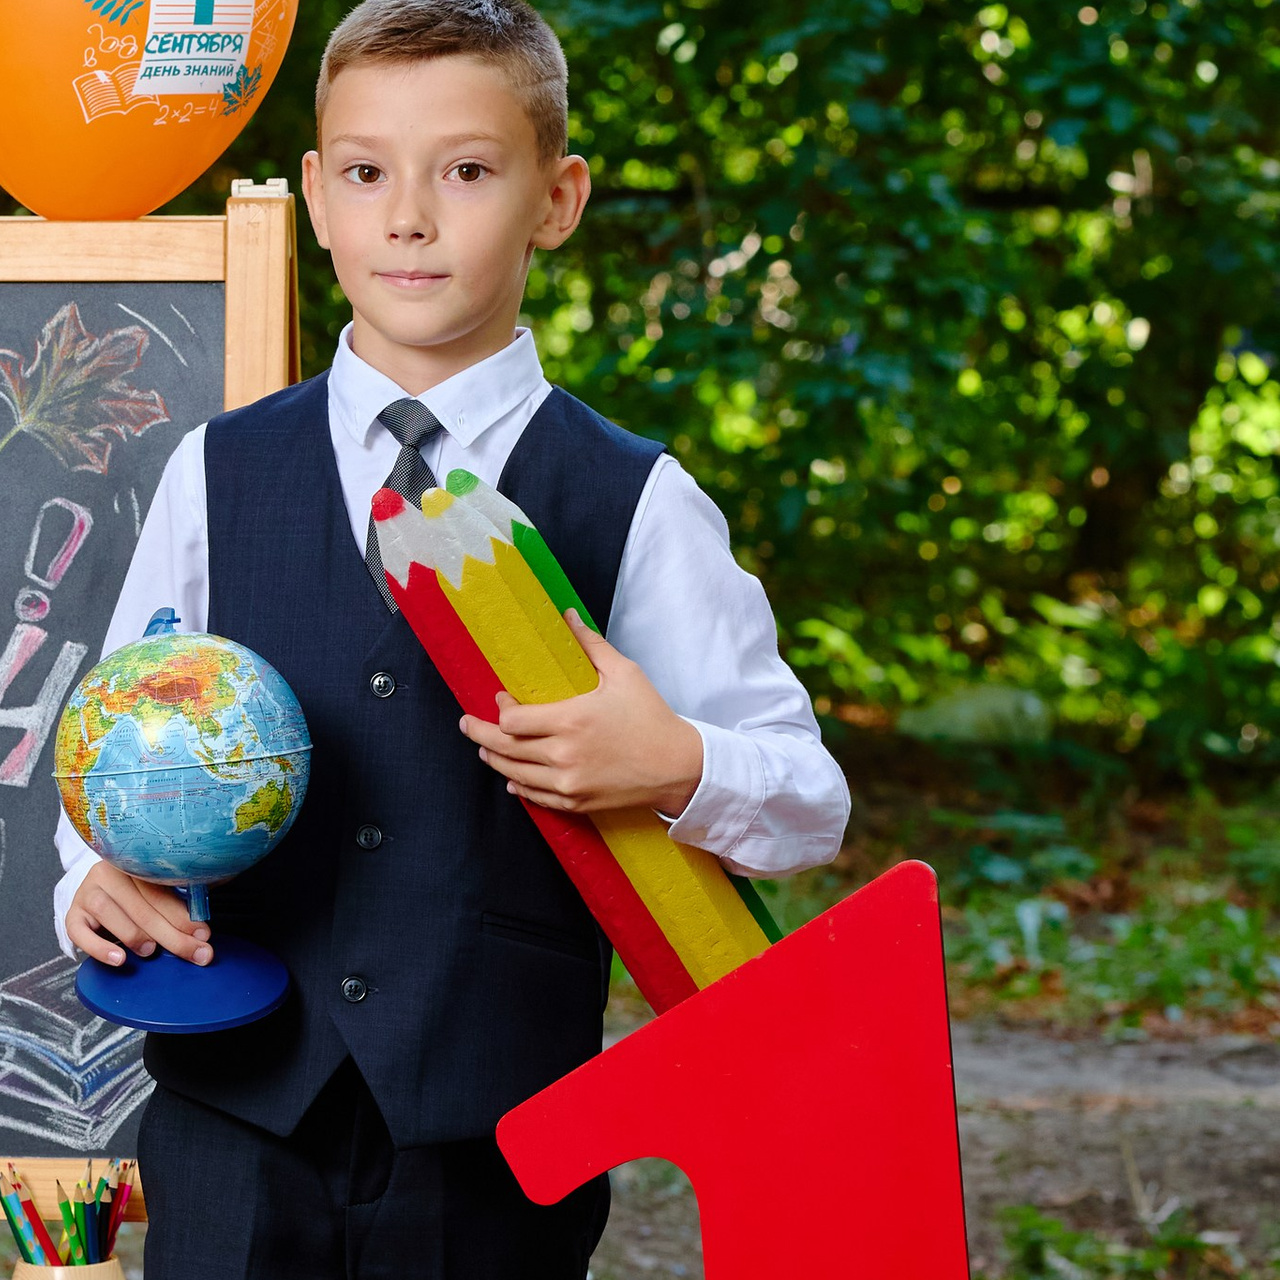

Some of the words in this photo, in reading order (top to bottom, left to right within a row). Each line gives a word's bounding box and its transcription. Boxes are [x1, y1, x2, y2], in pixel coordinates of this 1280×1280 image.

[144, 32, 243, 55] СЕНТЯБРЯ
[140, 65, 181, 80] ДЕНЬ
[183, 63, 235, 77] ЗНАНИЙ
